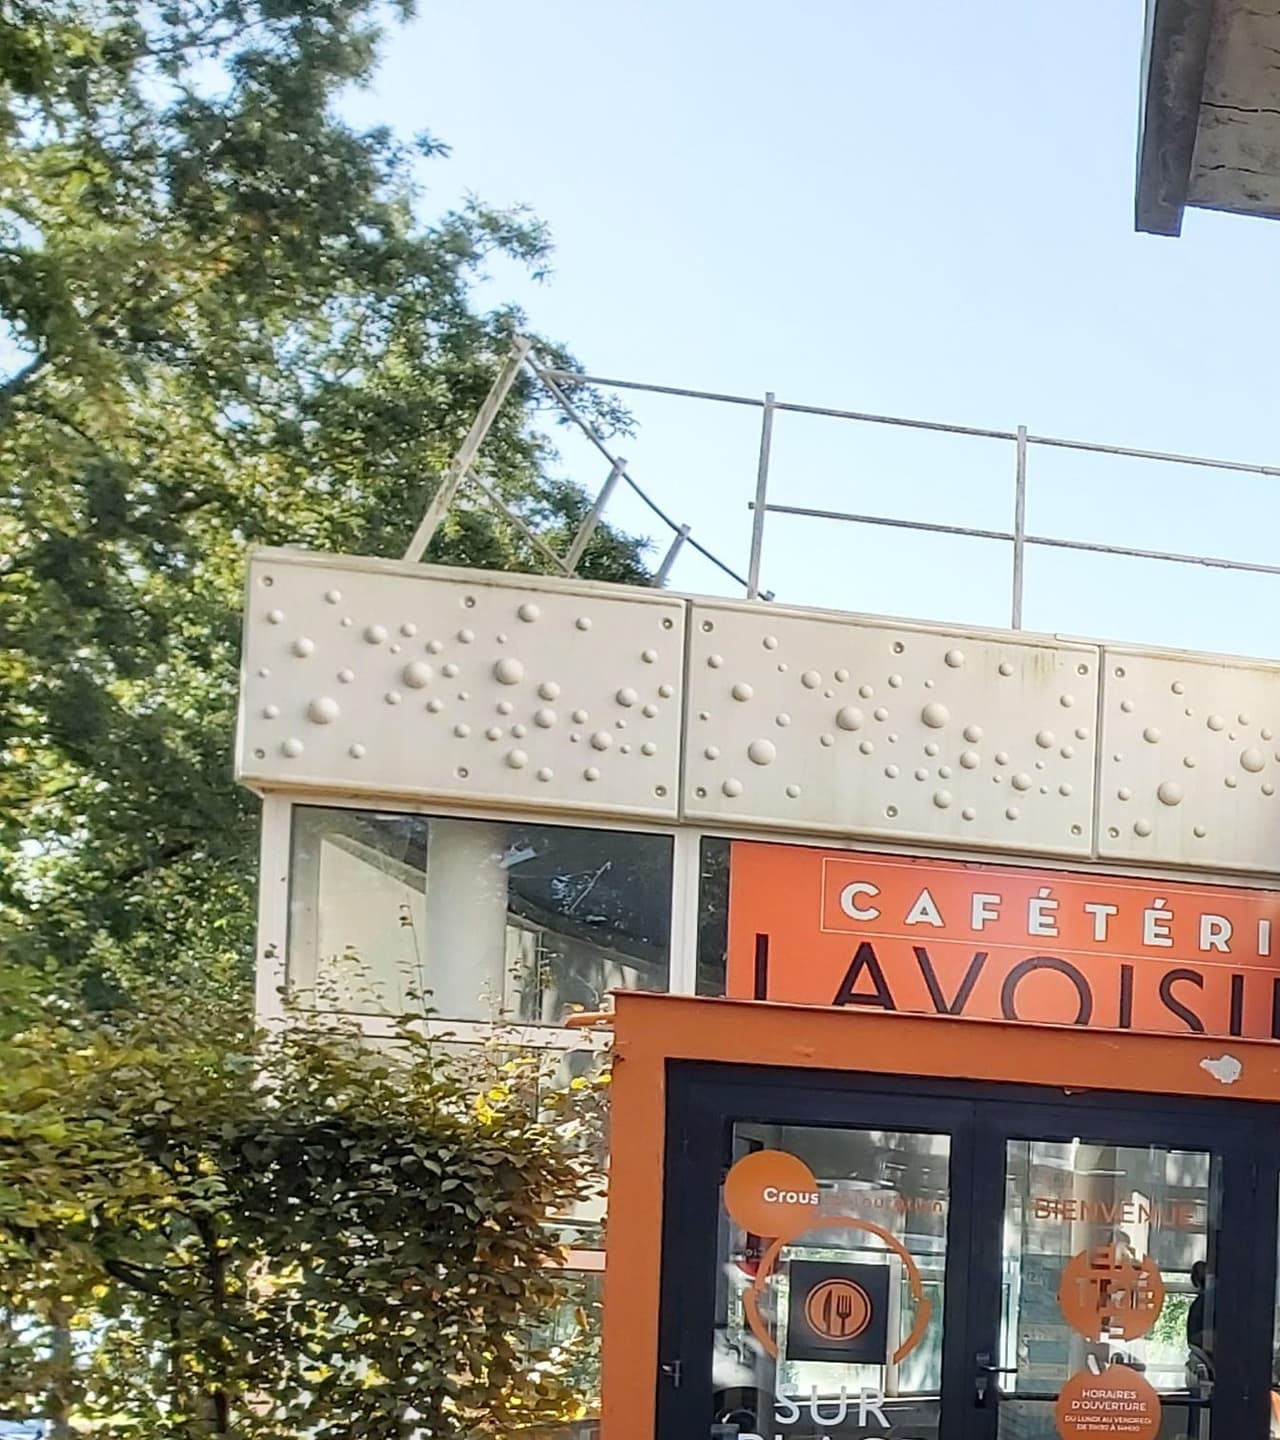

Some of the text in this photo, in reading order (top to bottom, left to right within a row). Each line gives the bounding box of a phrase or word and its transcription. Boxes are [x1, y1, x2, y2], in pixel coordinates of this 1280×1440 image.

[763, 1187, 820, 1206] Crous
[1082, 1389, 1137, 1400] HORAIRES
[775, 1383, 891, 1428] SUR
[1071, 1400, 1147, 1411] D'OUVERTURE
